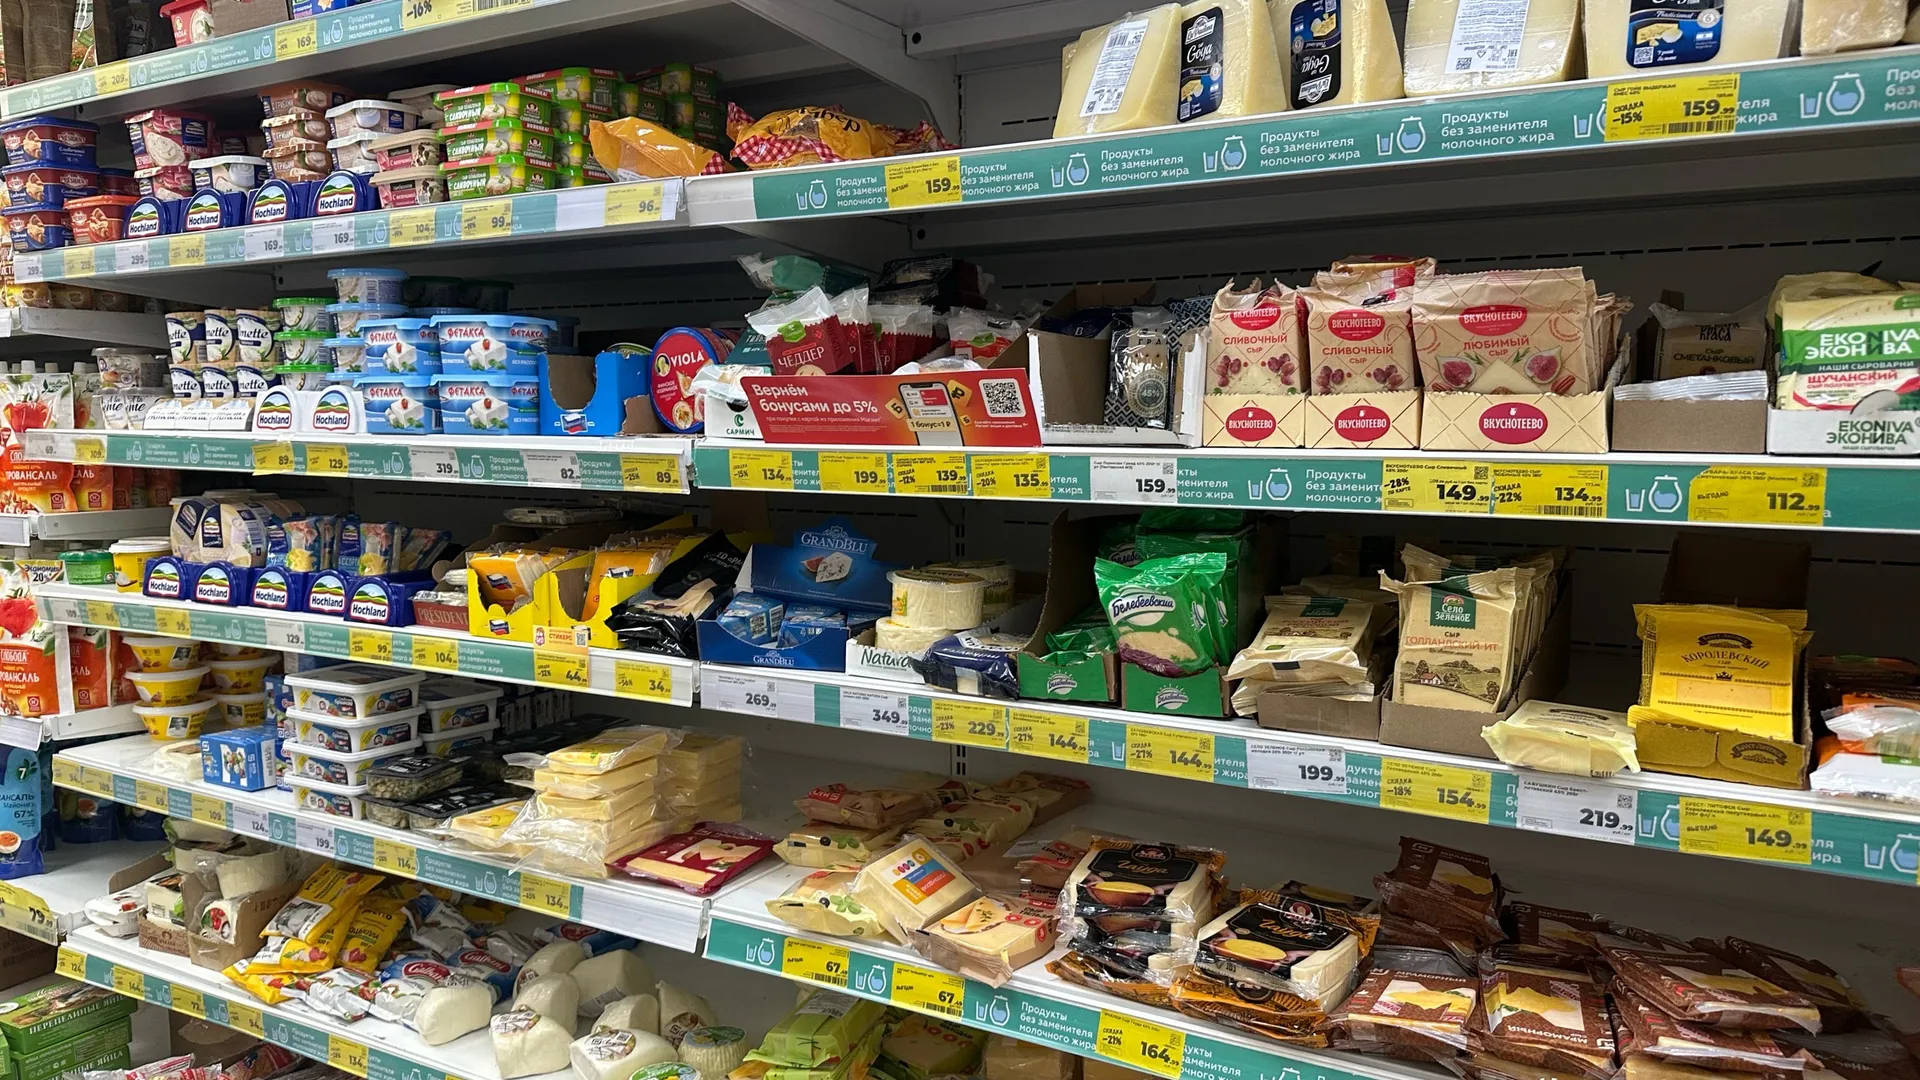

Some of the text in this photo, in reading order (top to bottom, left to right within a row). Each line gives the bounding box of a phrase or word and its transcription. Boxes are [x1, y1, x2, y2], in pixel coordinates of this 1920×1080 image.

[407, 1, 432, 19] -16%
[296, 36, 313, 48] 169
[1886, 84, 1911, 97] без
[1613, 101, 1644, 113] СКИДКА
[1441, 108, 1509, 126] Продукты
[1612, 111, 1643, 125] -15%
[1441, 118, 1548, 138] без заменителя
[1260, 128, 1320, 145] Продукты
[1441, 130, 1555, 151] молочного жира
[1260, 137, 1354, 156] без заменителя
[1100, 147, 1153, 162] Продукты
[1260, 148, 1361, 168] молочного жира
[961, 163, 1007, 176] Продукты
[1100, 155, 1184, 172] без заменителя
[961, 171, 1035, 187] без заменителя
[1101, 166, 1190, 184] молочного жира
[836, 176, 877, 190] Продукты
[961, 181, 1040, 197] молочного жира
[319, 196, 354, 213] Hochland
[836, 195, 883, 209] молочного
[254, 204, 286, 221] Hochland
[129, 221, 158, 235] Hochland
[188, 213, 219, 229] Hochland
[1232, 306, 1279, 320] ВКУСНОТЕЕВО
[1462, 309, 1523, 325] ВКУСНОТЕЕВО
[1331, 317, 1382, 330] ВКУСНОТЕЕВО
[369, 331, 398, 343] ФЕТАКСА
[447, 326, 475, 338] ФЕТАКСА
[508, 327, 534, 339] ФЕТАКСА
[1699, 326, 1733, 343] КРАСА
[1829, 326, 1919, 349] EKONIVA
[1222, 333, 1288, 347] СЛИВОЧНЫЙ
[1462, 336, 1531, 352] ЛЮБИМЫЙ
[777, 345, 826, 369] ЧЕДДЕР
[1246, 346, 1263, 355] СЫР
[1321, 343, 1394, 357] СЛИВОЧНЫЙ
[1488, 347, 1509, 358] СЫР
[1803, 340, 1915, 361] ЭКОНИВА
[670, 349, 705, 369] VIOLA
[1349, 356, 1367, 366] СЫР
[1672, 351, 1756, 366] СМЕТАНКОВЫЙ
[1818, 360, 1915, 373] НАШИ СЫРОВАРНИ
[1817, 368, 1909, 386] ЩУЧАНСКИЙ
[369, 387, 403, 399] ФЕТАКСА
[447, 385, 476, 398] ФЕТАКСА
[751, 383, 809, 399] Вернём
[759, 399, 878, 417] бонусами до 5%
[259, 413, 290, 427] Hochland
[315, 413, 348, 427] Hochland
[1228, 418, 1273, 430] ВКУСНОТЕЕВО
[1337, 417, 1387, 430] ВКУСНОТЕЕВО
[1483, 417, 1544, 430] ВКУСНОТЕЕВО
[1847, 419, 1915, 434] EKONIVA
[726, 426, 756, 437] САРМИЧ
[1825, 432, 1908, 446] ЭКОНИВА
[328, 458, 345, 469] 129
[436, 462, 453, 474] 319
[898, 476, 916, 485] -12%
[976, 477, 997, 488] -20%
[1305, 471, 1367, 485] Продукты
[1383, 477, 1410, 489] -28%
[1305, 483, 1325, 494] без
[1493, 482, 1522, 492] СКИДКА
[1205, 491, 1234, 504] жира
[1305, 494, 1372, 507] молочного
[1495, 491, 1522, 504] -22%
[1697, 491, 1729, 500] ВЫГОДНО
[800, 531, 869, 554] GRANDBLU
[24, 563, 61, 574] Экономия
[149, 581, 178, 594] Hochland
[197, 586, 228, 600] Hochland
[255, 590, 286, 605] Hochland
[311, 595, 344, 610] Hochland
[350, 603, 387, 619] Hochland
[1111, 593, 1175, 618] Белебеевский
[1441, 603, 1464, 614] Село
[416, 607, 468, 626] PRÉSIDENT
[1444, 631, 1461, 639] СЫР
[1406, 635, 1499, 652] ГОЛЛАНДСКИЙ ИТ
[752, 655, 795, 667] GRANDBLU
[1681, 649, 1771, 670] КОРОЛЕВСКИЙ
[935, 721, 955, 732] -23%
[1386, 778, 1413, 786] СКИДКА
[1523, 780, 1557, 790] САВУШКИН
[1556, 785, 1569, 793] Сыр
[1386, 785, 1412, 797] -18%
[14, 809, 35, 819] 67%
[1686, 823, 1718, 833] ВЫГОДНО
[315, 837, 330, 849] 199
[396, 857, 412, 870] 114
[545, 894, 563, 908] 134
[1395, 970, 1467, 984] МРАМОРНЫЙ
[1020, 1000, 1068, 1022] Продукты
[28, 1001, 101, 1036] ПЕРЕПЕЛИНЫЕ
[1019, 1012, 1094, 1039] без заменителя
[1018, 1023, 1097, 1053] молочного жира
[1102, 1027, 1124, 1036] СКИДКА
